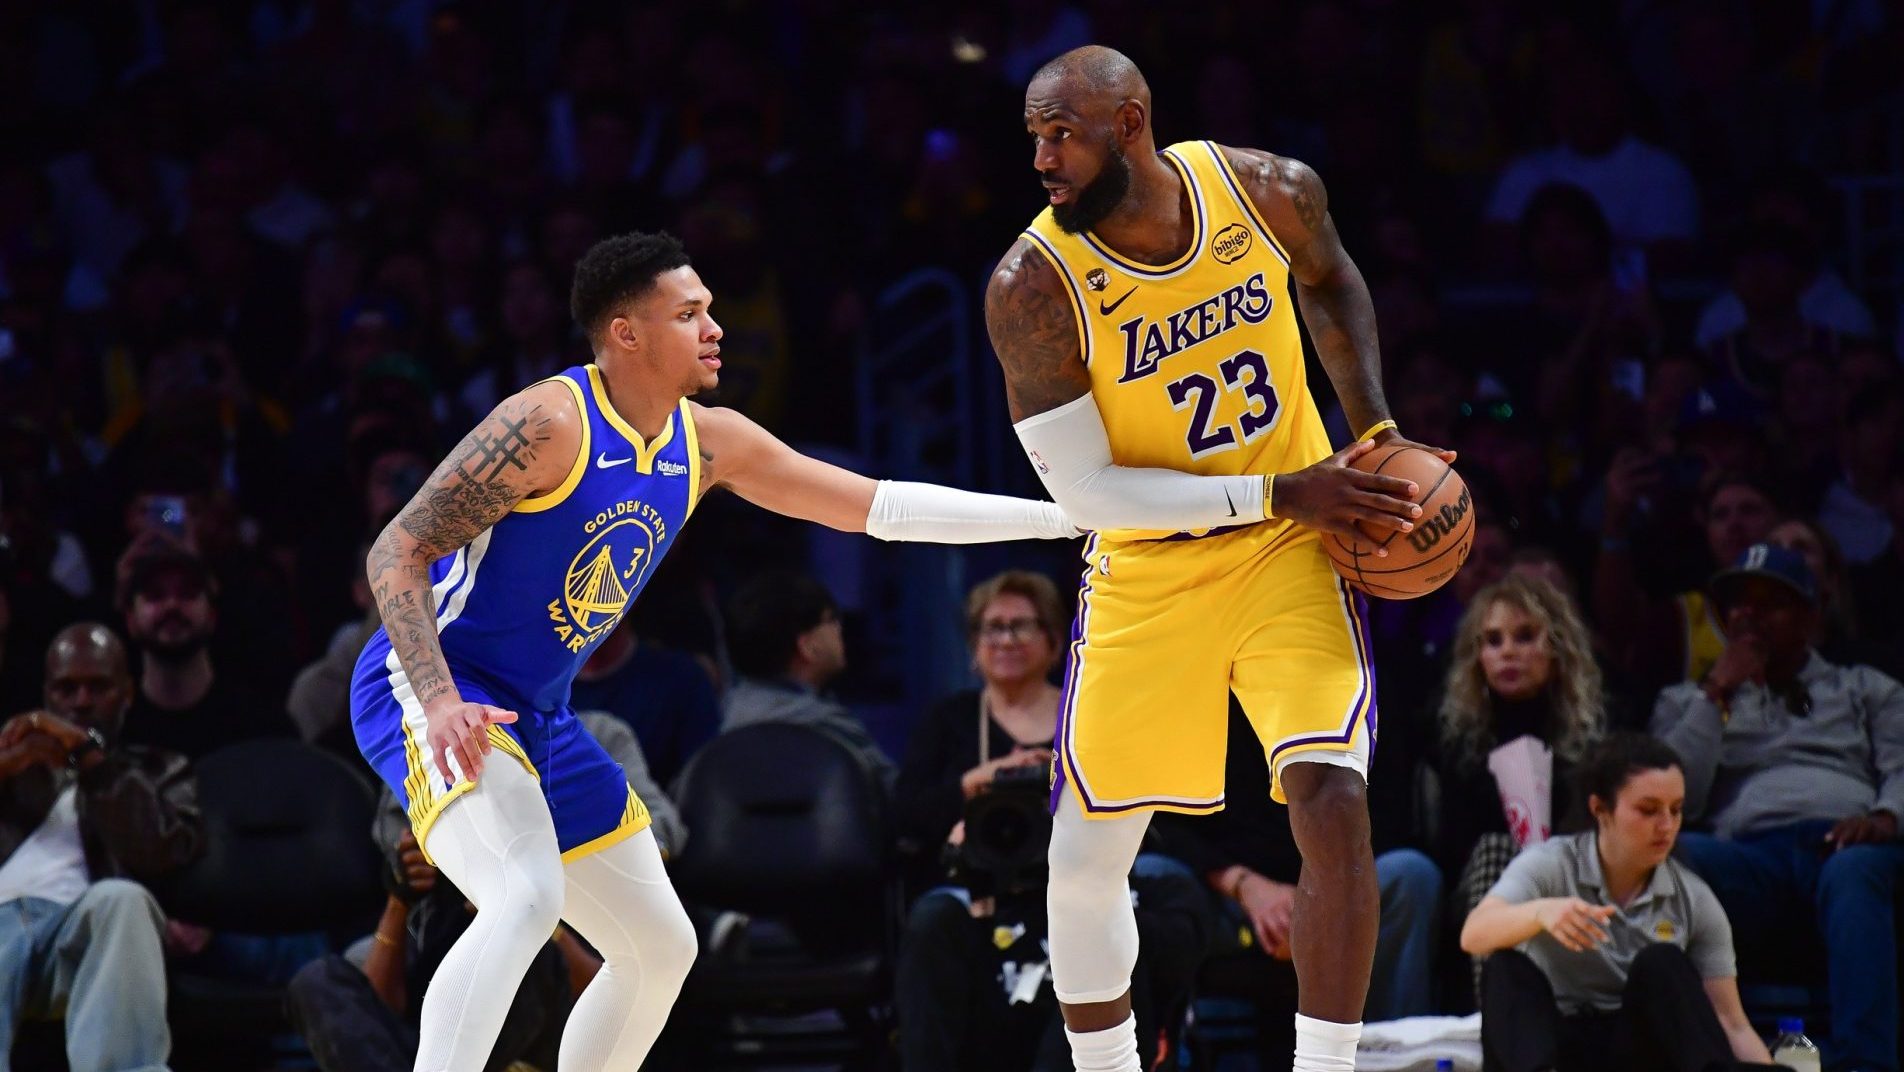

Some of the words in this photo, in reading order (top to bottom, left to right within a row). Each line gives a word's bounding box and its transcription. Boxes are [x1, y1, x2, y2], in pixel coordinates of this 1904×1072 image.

[1214, 231, 1248, 255] bibigo
[1117, 273, 1272, 384] LAKERS
[1166, 350, 1282, 461] 23
[657, 460, 688, 475] Rakuten
[584, 500, 641, 534] GOLDEN
[641, 504, 666, 544] STATE
[1406, 484, 1471, 553] Wilson
[624, 548, 645, 578] 3
